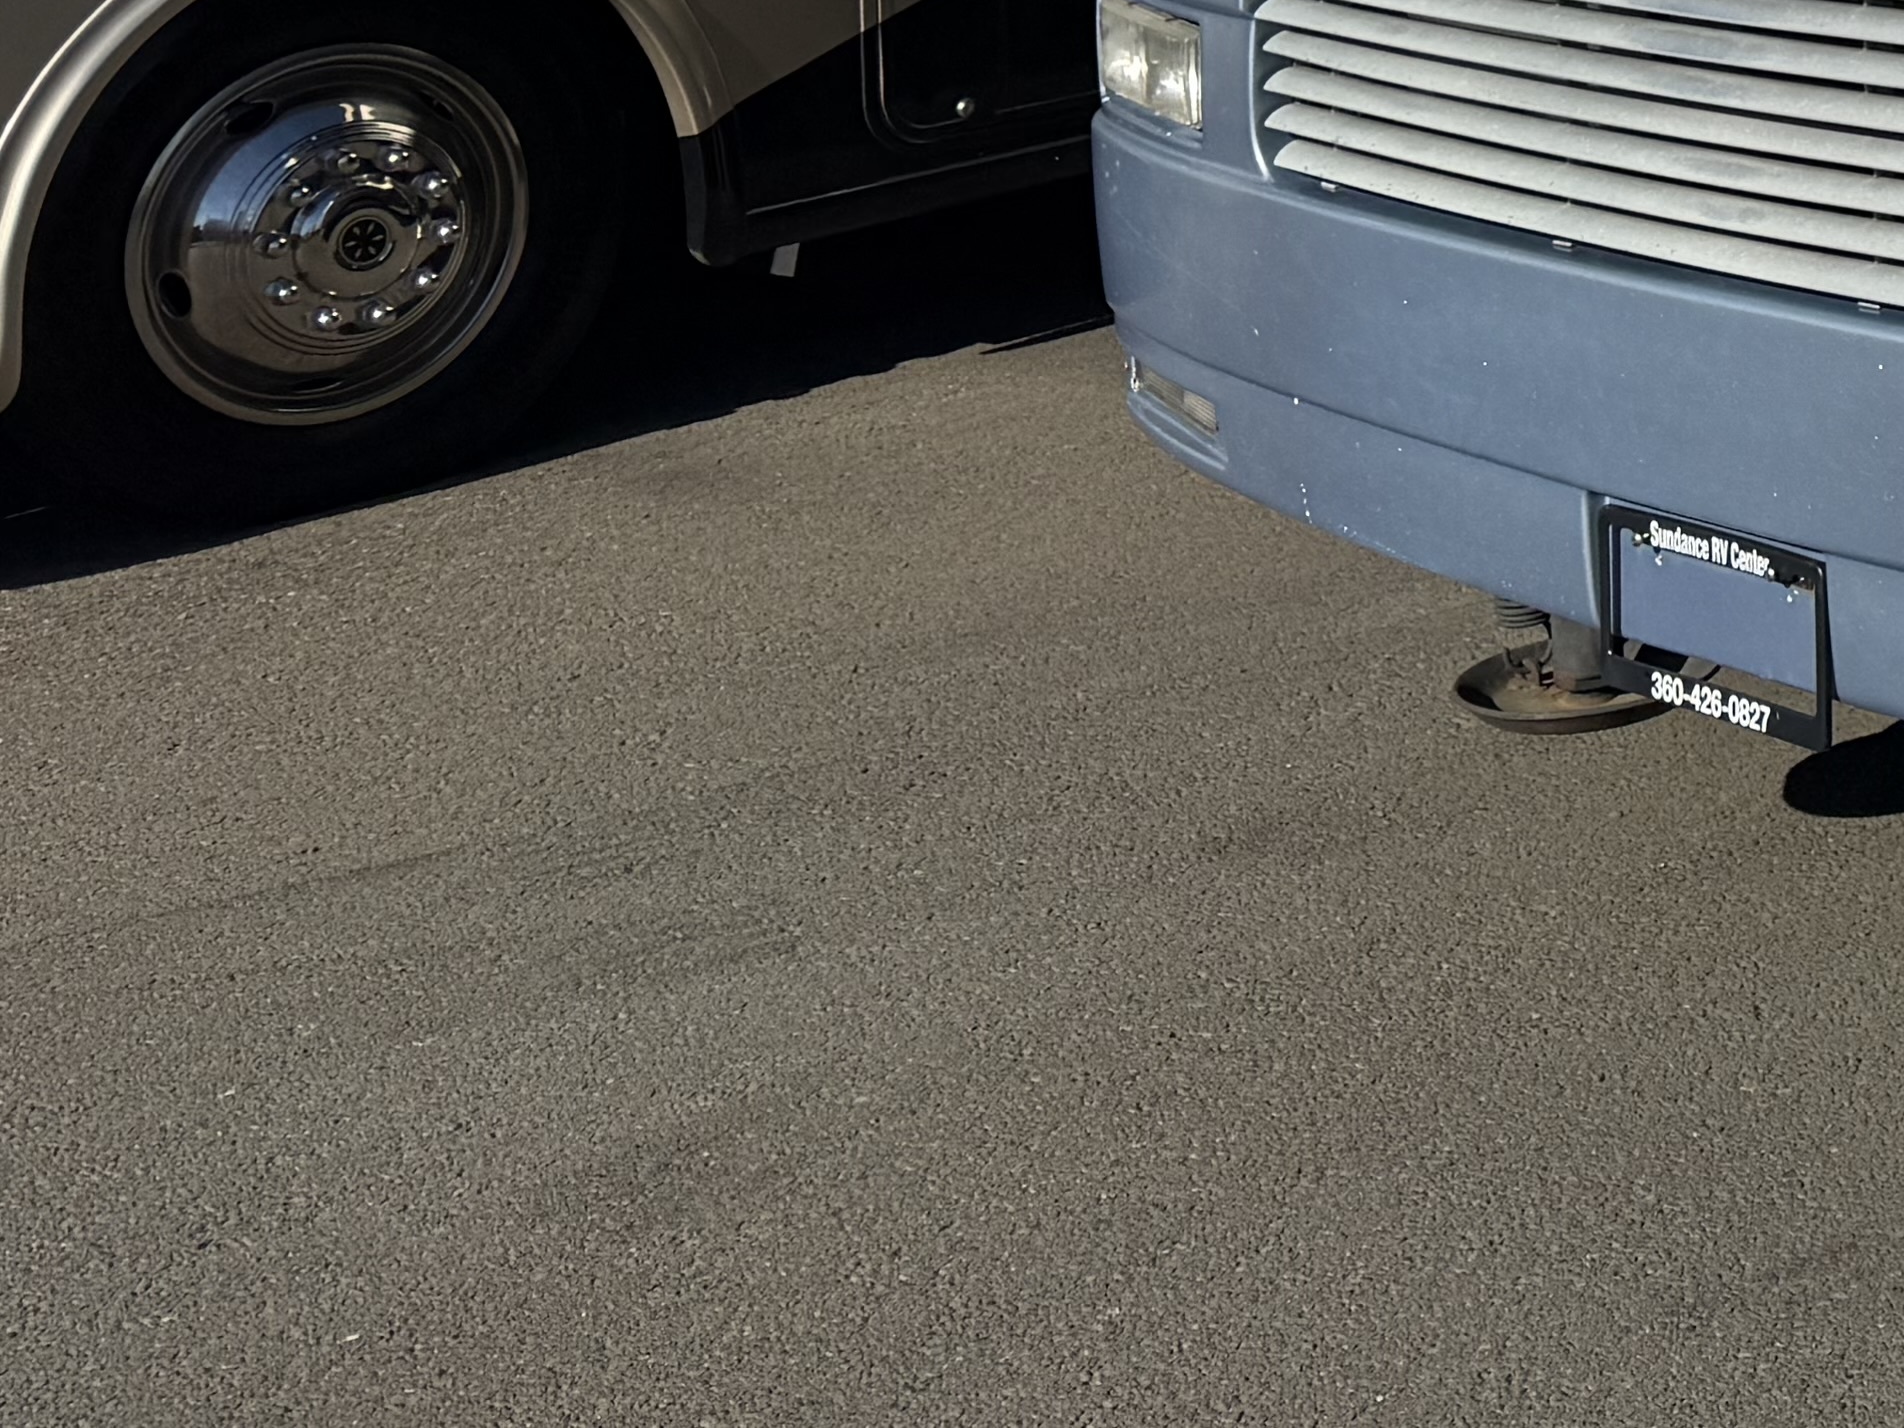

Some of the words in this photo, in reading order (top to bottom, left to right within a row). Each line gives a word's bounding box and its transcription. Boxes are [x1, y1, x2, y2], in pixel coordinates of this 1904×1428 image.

[1649, 519, 1710, 560] Sundance
[1711, 535, 1729, 566] RV
[1730, 541, 1770, 577] Center
[1650, 670, 1771, 733] 360-426-0827
